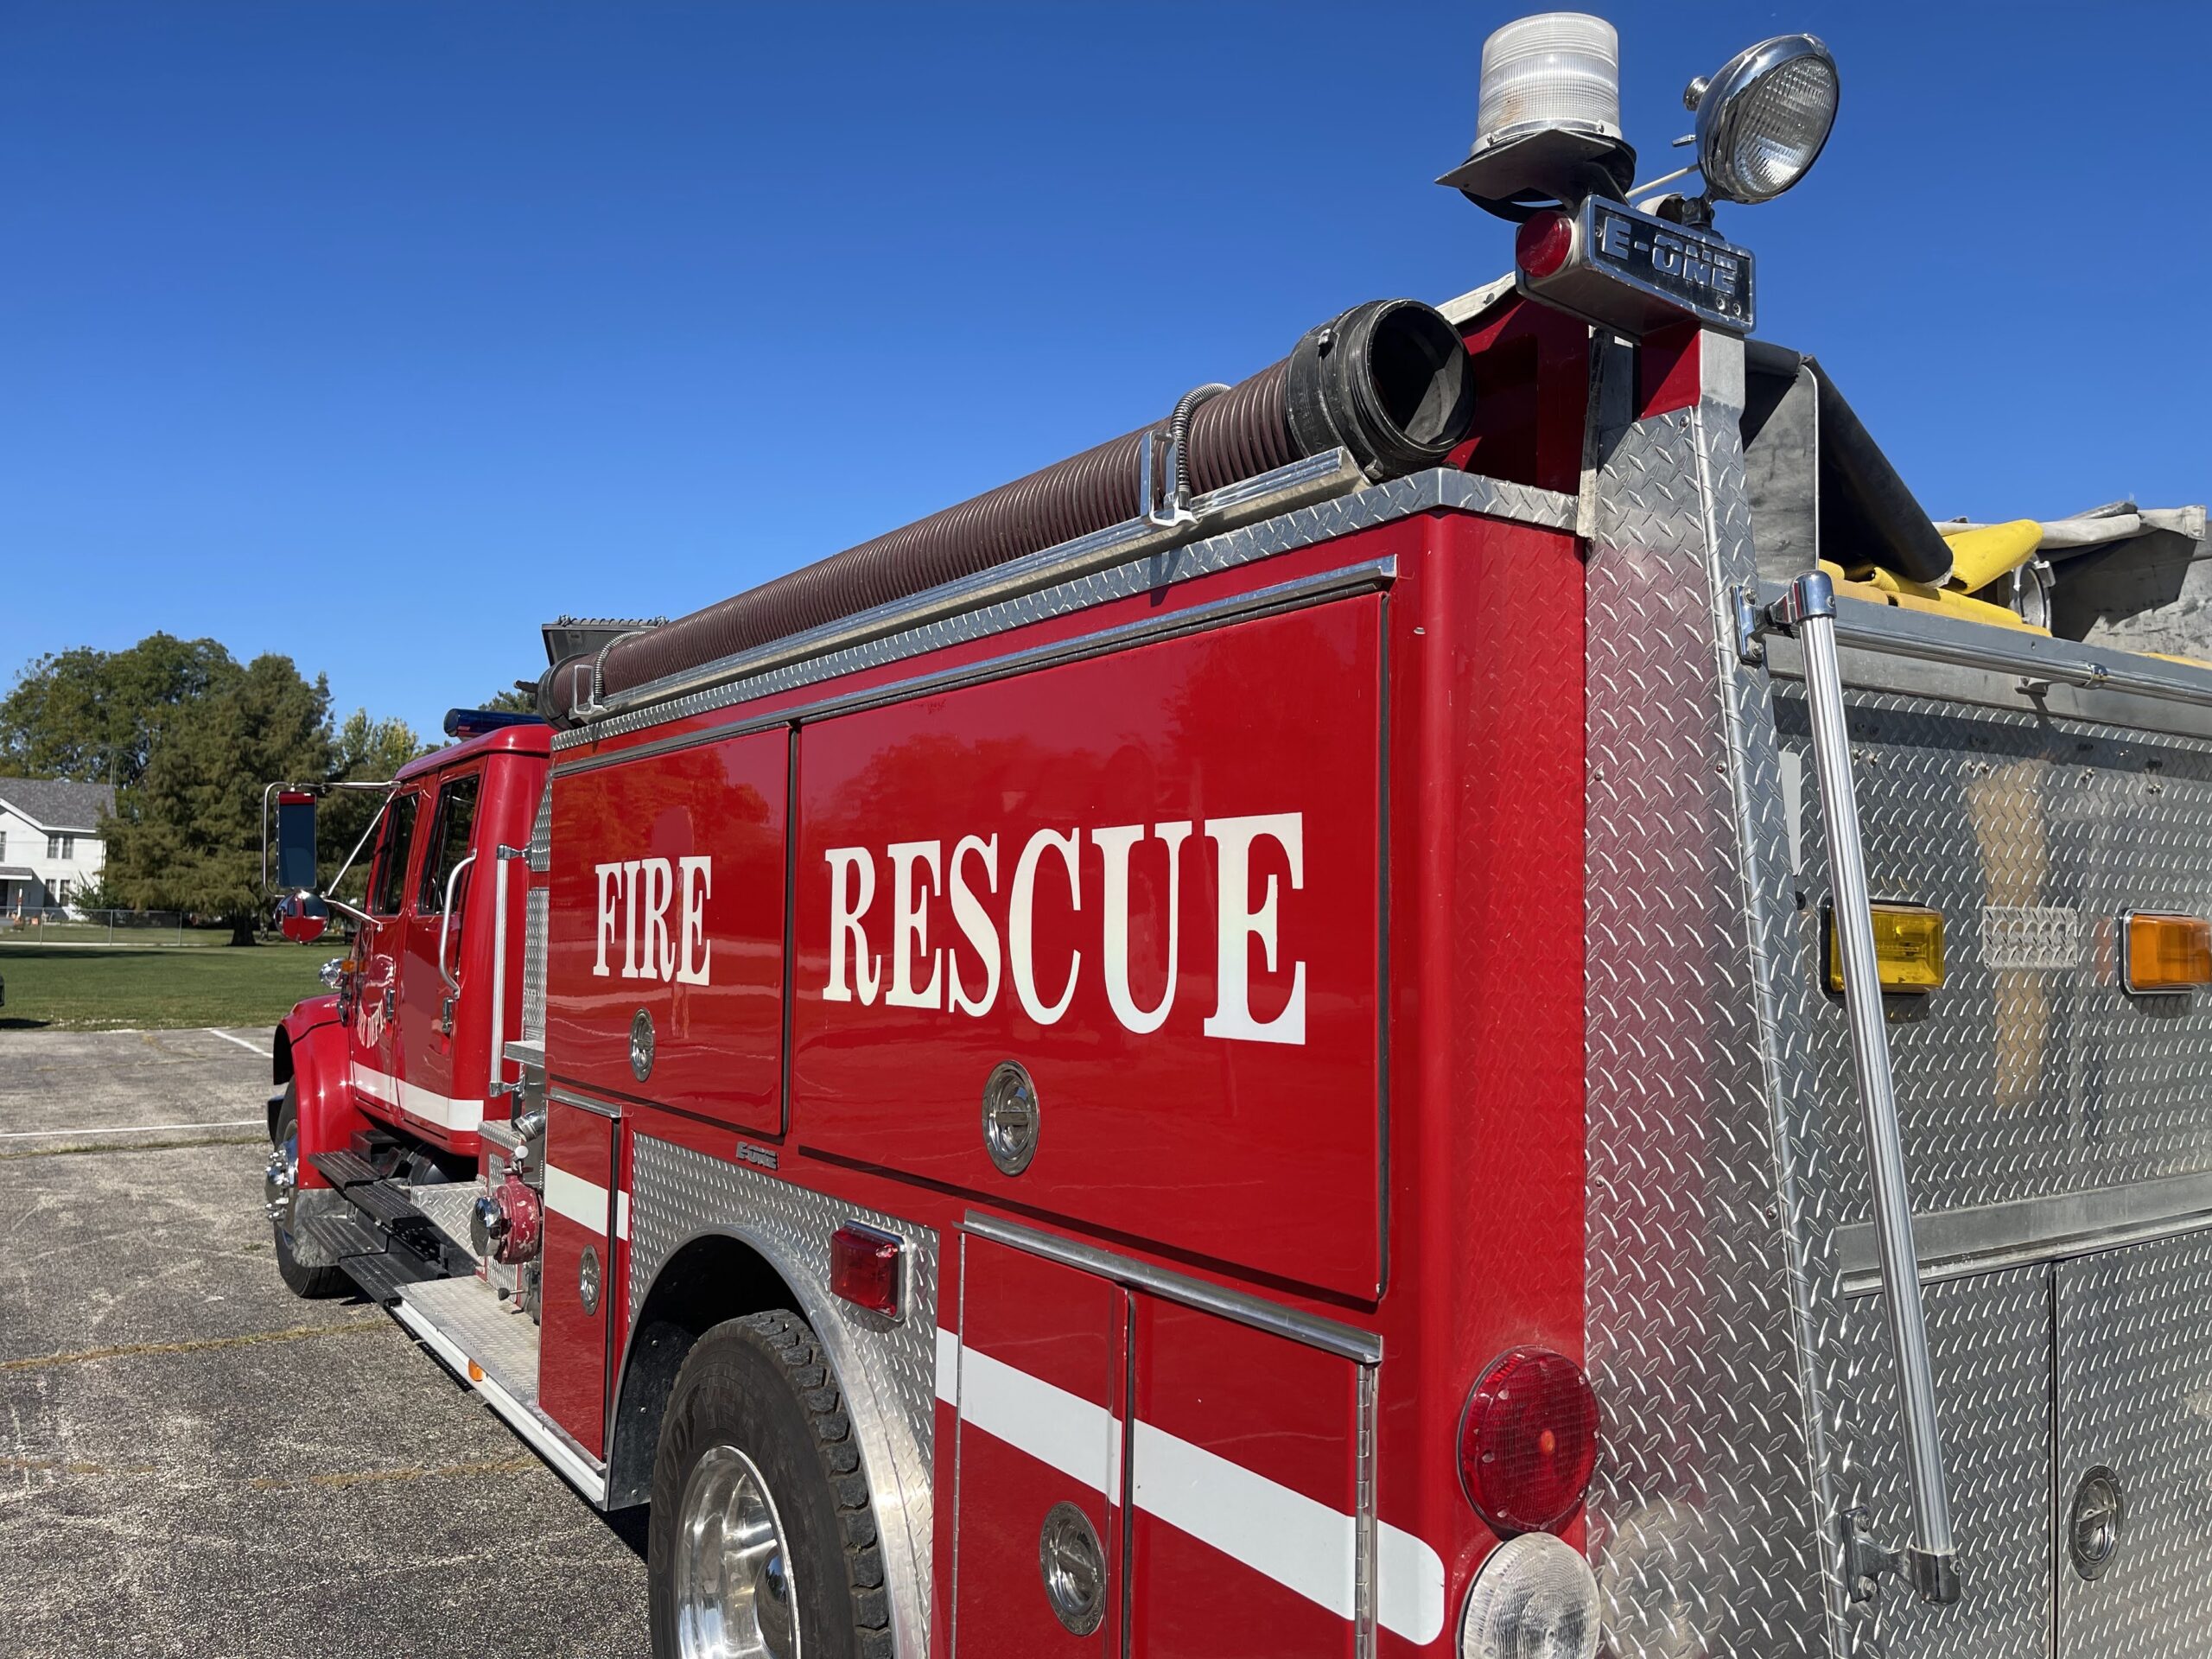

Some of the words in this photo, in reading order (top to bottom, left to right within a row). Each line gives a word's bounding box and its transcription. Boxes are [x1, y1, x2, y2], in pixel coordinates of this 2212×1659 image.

[1601, 216, 1738, 296] E-ONE
[593, 855, 712, 987] FIRE
[822, 811, 1306, 1046] RESCUE
